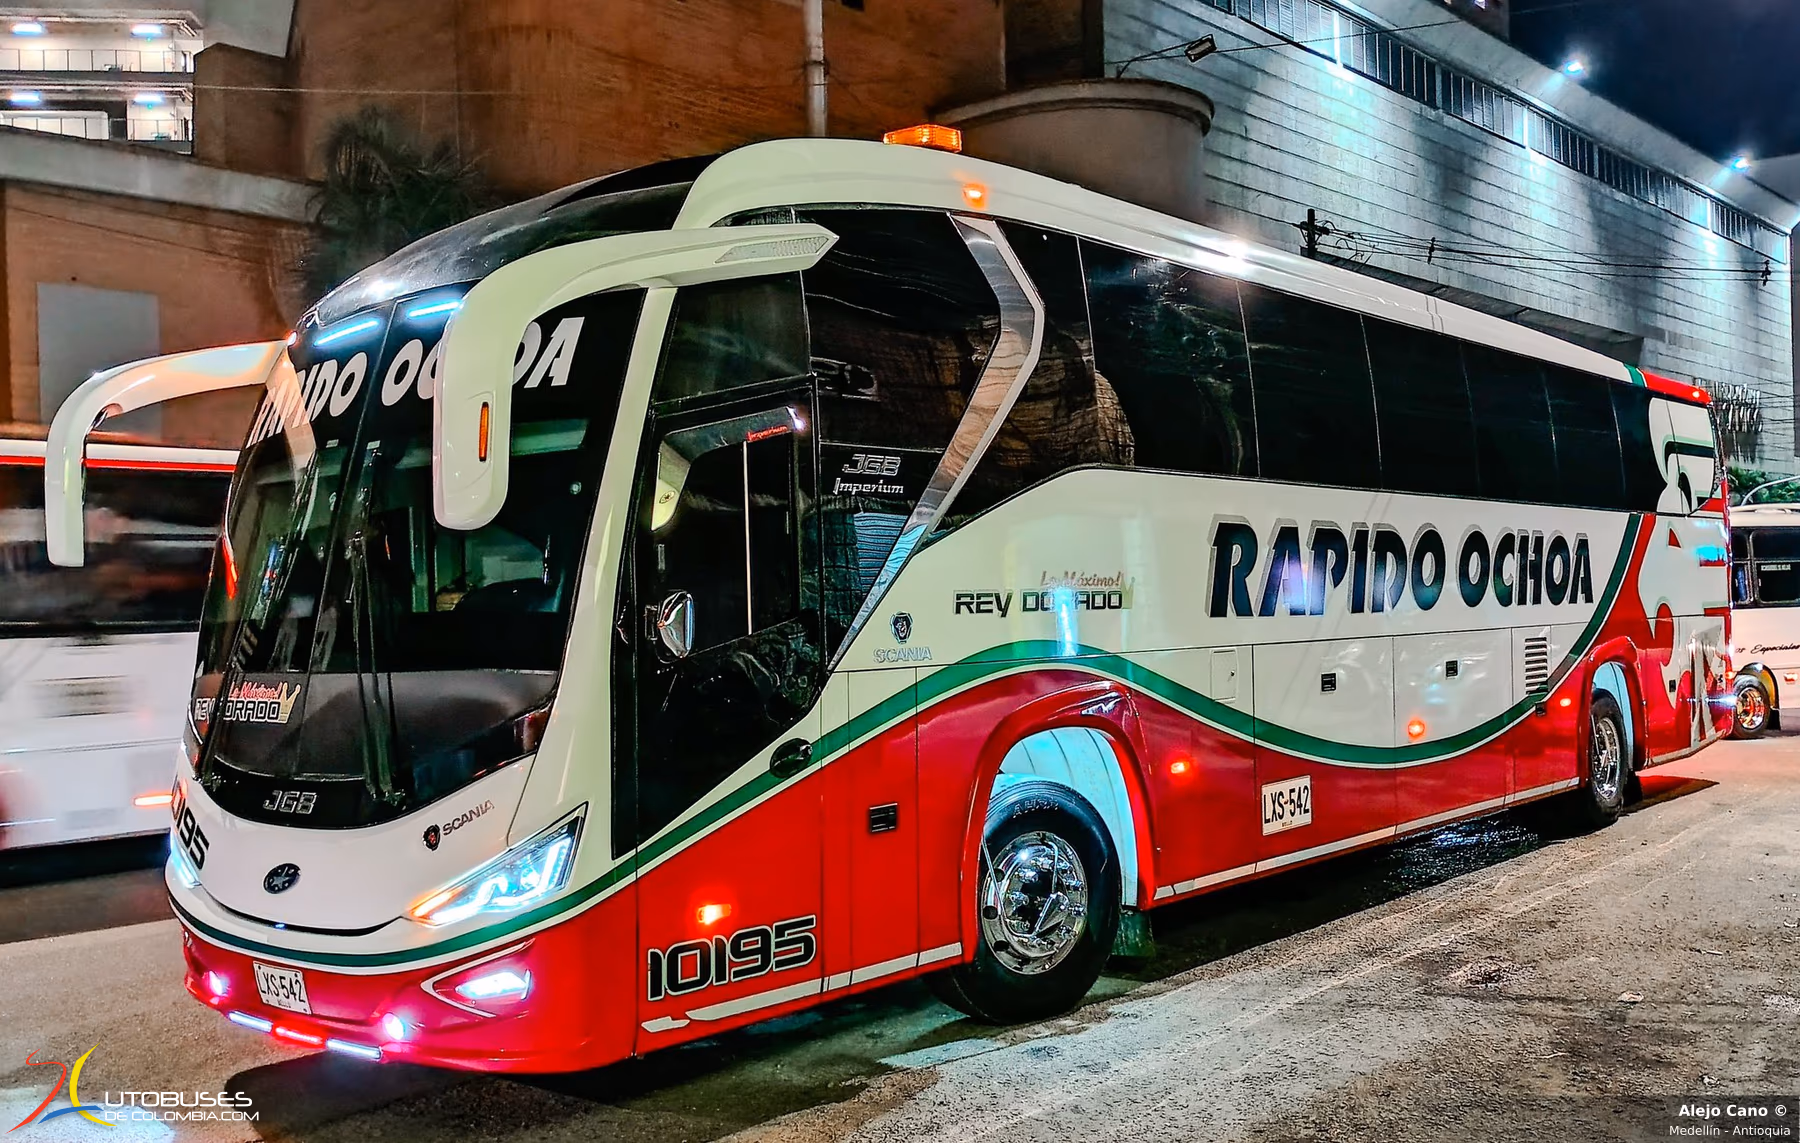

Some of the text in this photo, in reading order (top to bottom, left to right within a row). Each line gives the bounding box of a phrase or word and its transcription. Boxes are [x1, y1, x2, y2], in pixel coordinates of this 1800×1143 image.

[381, 316, 585, 406] OCOA
[842, 454, 901, 476] JGB
[833, 478, 904, 495] Imperium
[1204, 513, 1594, 618] RAPIDO OCHOA
[953, 590, 1123, 618] REY DOADO
[873, 646, 932, 663] SCANIA
[218, 699, 281, 722] ORADO
[262, 790, 317, 815] JGB
[442, 799, 495, 836] SCANIA
[1263, 785, 1310, 824] LXS-542
[171, 773, 210, 870] 0195
[648, 914, 816, 1002] 10195
